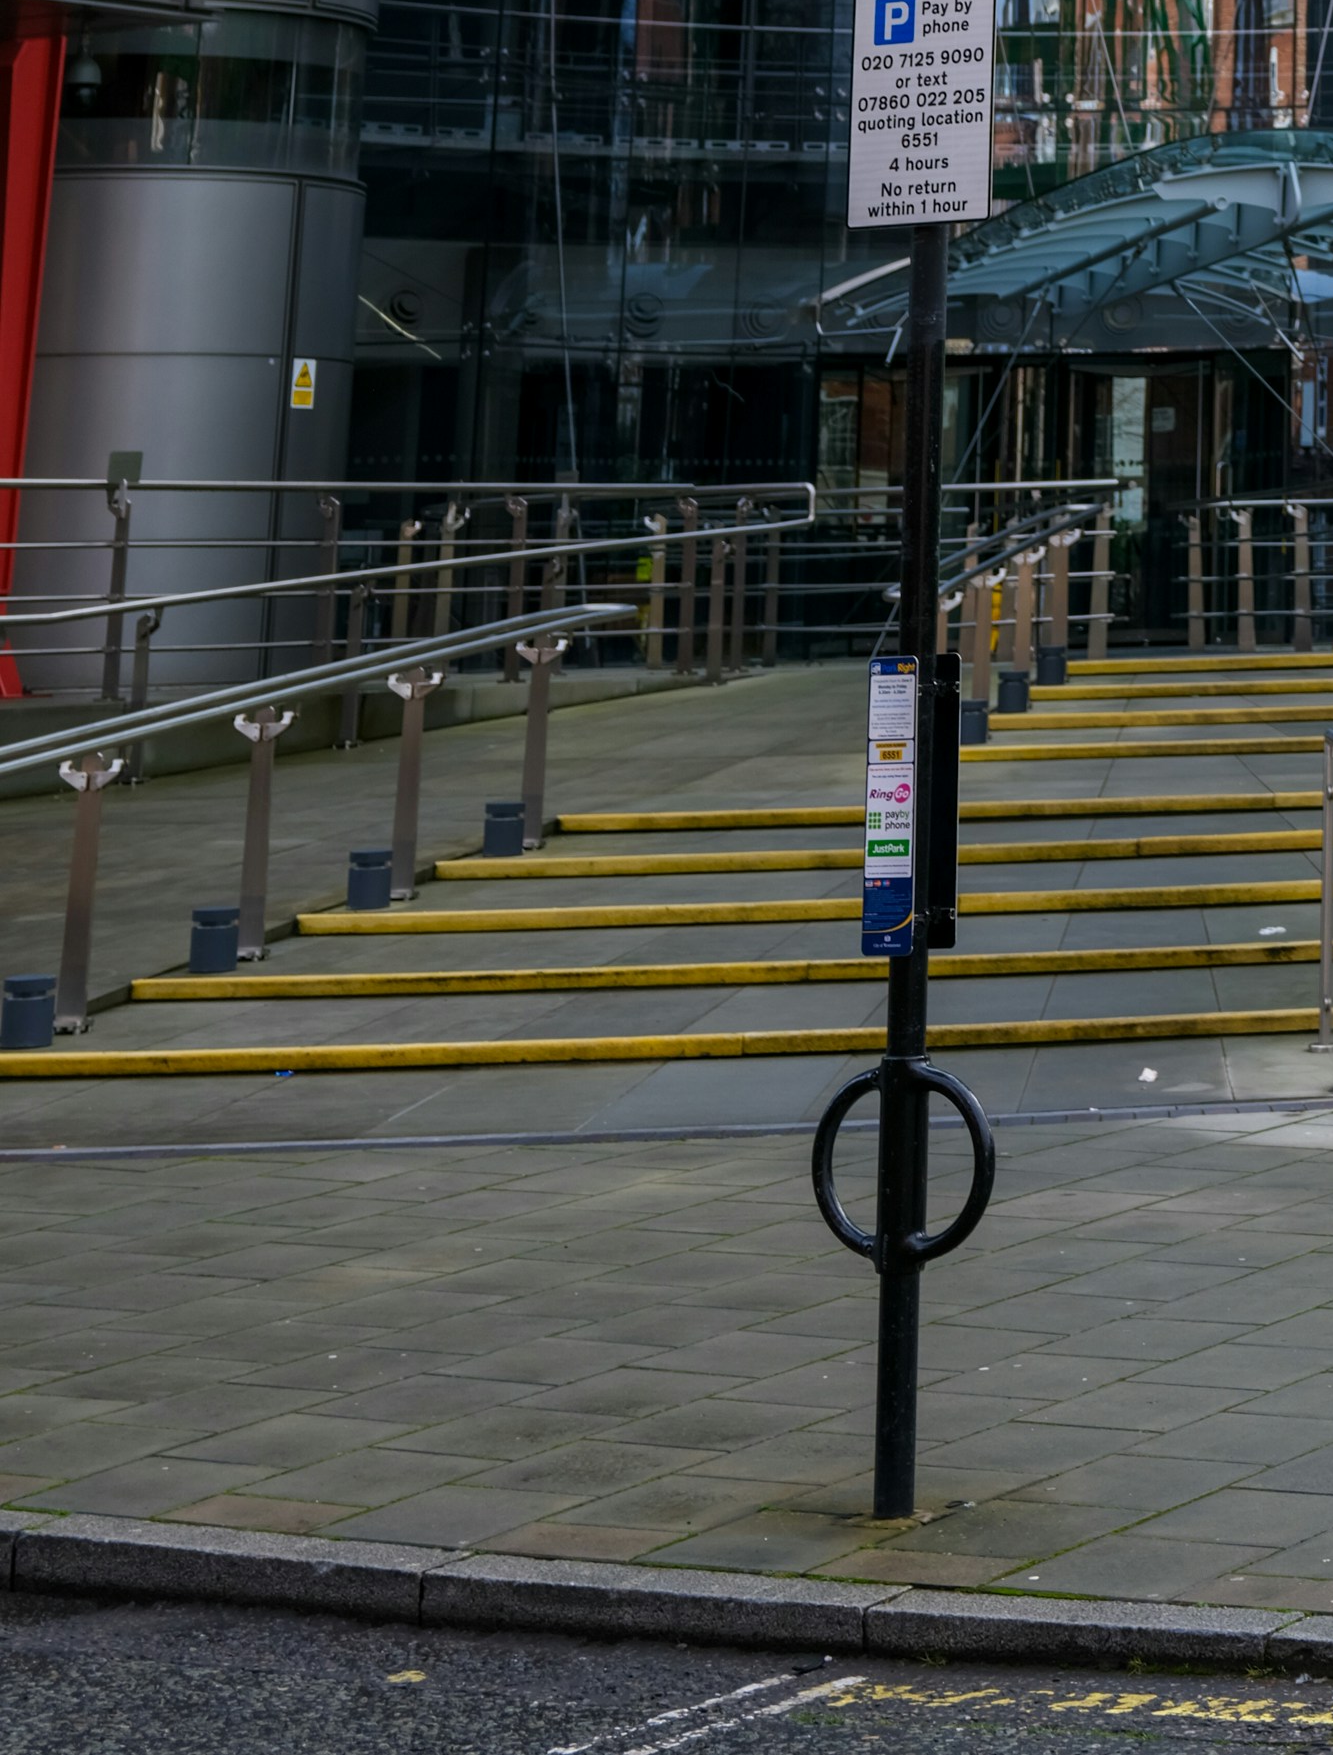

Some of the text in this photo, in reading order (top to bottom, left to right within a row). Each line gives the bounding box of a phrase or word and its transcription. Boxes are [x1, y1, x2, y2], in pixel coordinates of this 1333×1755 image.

[922, 0, 972, 16] Pay by
[884, 0, 910, 41] P
[923, 19, 969, 37] phone
[862, 47, 984, 71] 020 7125 9090
[896, 71, 947, 89] or text
[858, 88, 985, 112] 07860 022 205
[858, 109, 983, 134] quoting location
[901, 132, 938, 148] 6551
[889, 157, 948, 172] 4 hours
[881, 180, 956, 197] No return
[868, 199, 968, 217] within 1 hour
[882, 750, 899, 760] 6551
[869, 787, 910, 801] RingGo
[885, 821, 911, 831] phone
[872, 843, 905, 853] JustPark
